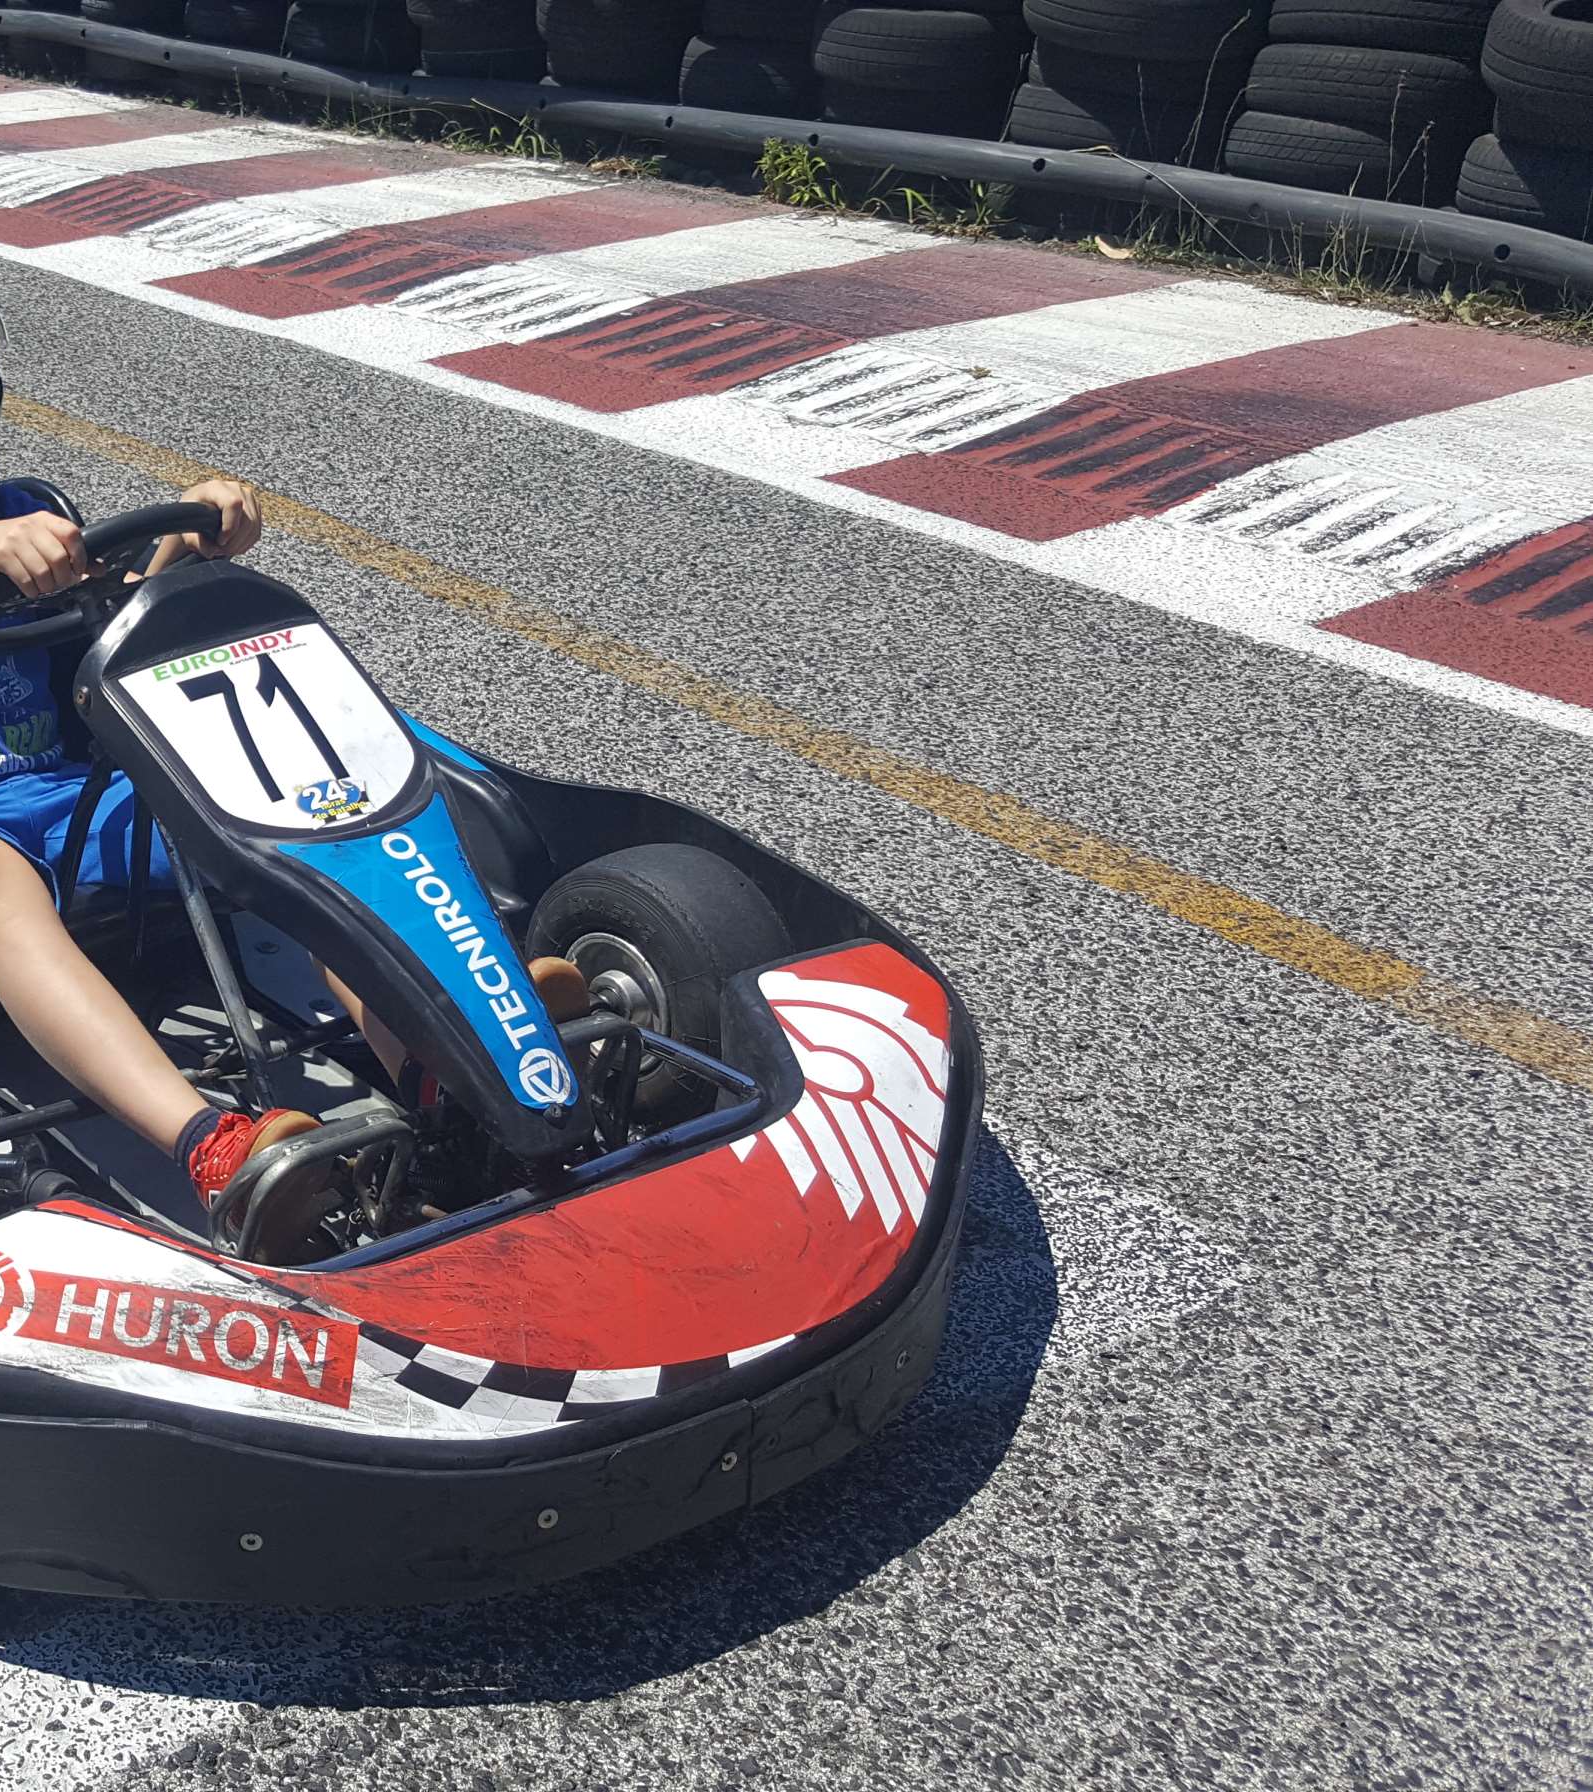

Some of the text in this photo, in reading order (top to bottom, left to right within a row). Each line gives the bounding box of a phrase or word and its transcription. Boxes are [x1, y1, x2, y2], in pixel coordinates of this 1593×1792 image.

[152, 630, 293, 681] EUROINDY
[176, 652, 351, 802] 71
[302, 780, 348, 810] 24
[381, 832, 538, 1050] TECNIROLO
[54, 1283, 330, 1388] HURON
